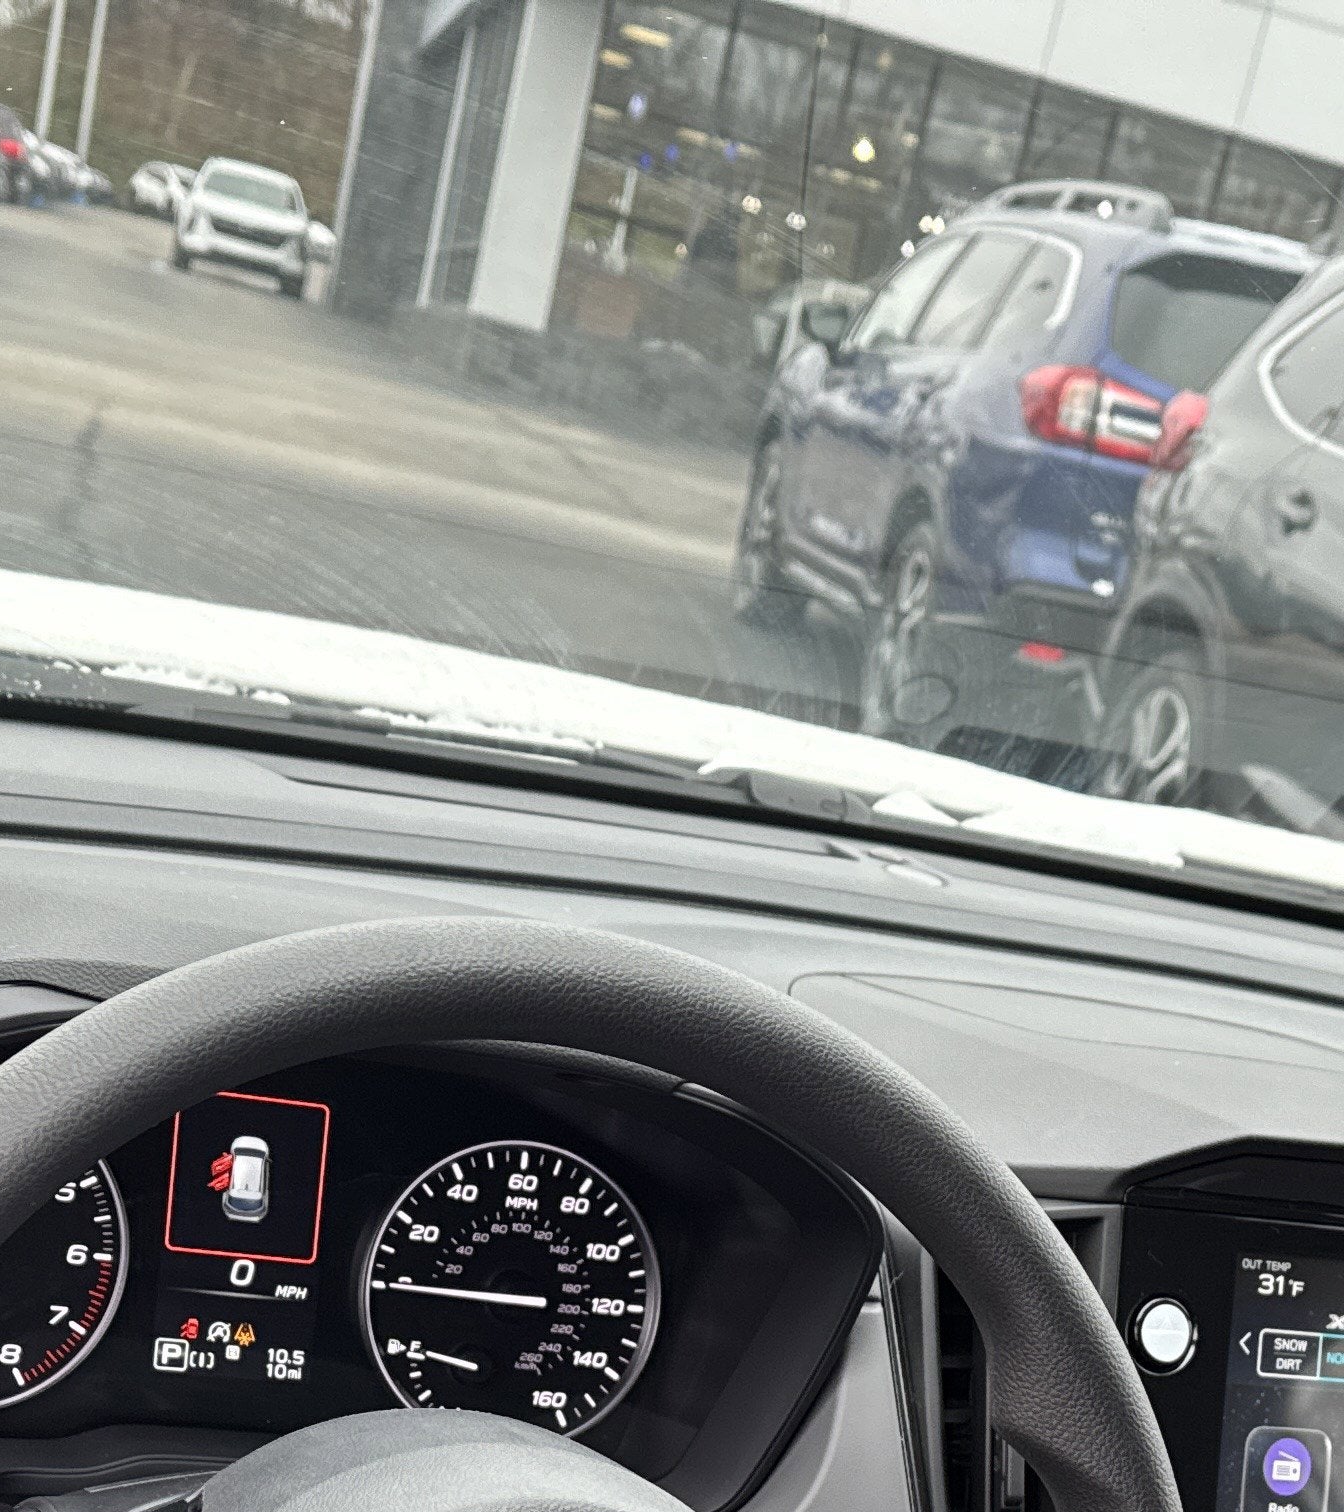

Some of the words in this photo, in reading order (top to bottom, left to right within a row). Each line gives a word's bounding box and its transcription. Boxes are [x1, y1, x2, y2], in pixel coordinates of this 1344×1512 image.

[508, 1174, 538, 1191] 60
[447, 1184, 478, 1201] 40
[506, 1196, 538, 1210] MPH
[560, 1197, 590, 1214] 80
[409, 1224, 440, 1242] 20
[512, 1222, 532, 1233] 100
[66, 1244, 88, 1265] 6
[456, 1245, 474, 1256] 40
[549, 1244, 569, 1255] 140
[586, 1243, 620, 1261] 100
[230, 1259, 255, 1286] 0
[445, 1263, 463, 1274] 20
[1242, 1258, 1262, 1270] OUT
[1266, 1260, 1292, 1272] TEMP
[274, 1284, 308, 1300] MPH
[48, 1305, 69, 1325] 7
[591, 1297, 625, 1316] 120
[550, 1323, 574, 1335] 220
[0, 1343, 22, 1364] 8
[537, 1342, 562, 1353] 240
[1274, 1338, 1308, 1352] SNOW
[267, 1348, 305, 1365] 10.5
[573, 1351, 607, 1369] 140
[1276, 1358, 1302, 1371] DIRT
[532, 1391, 567, 1408] 160
